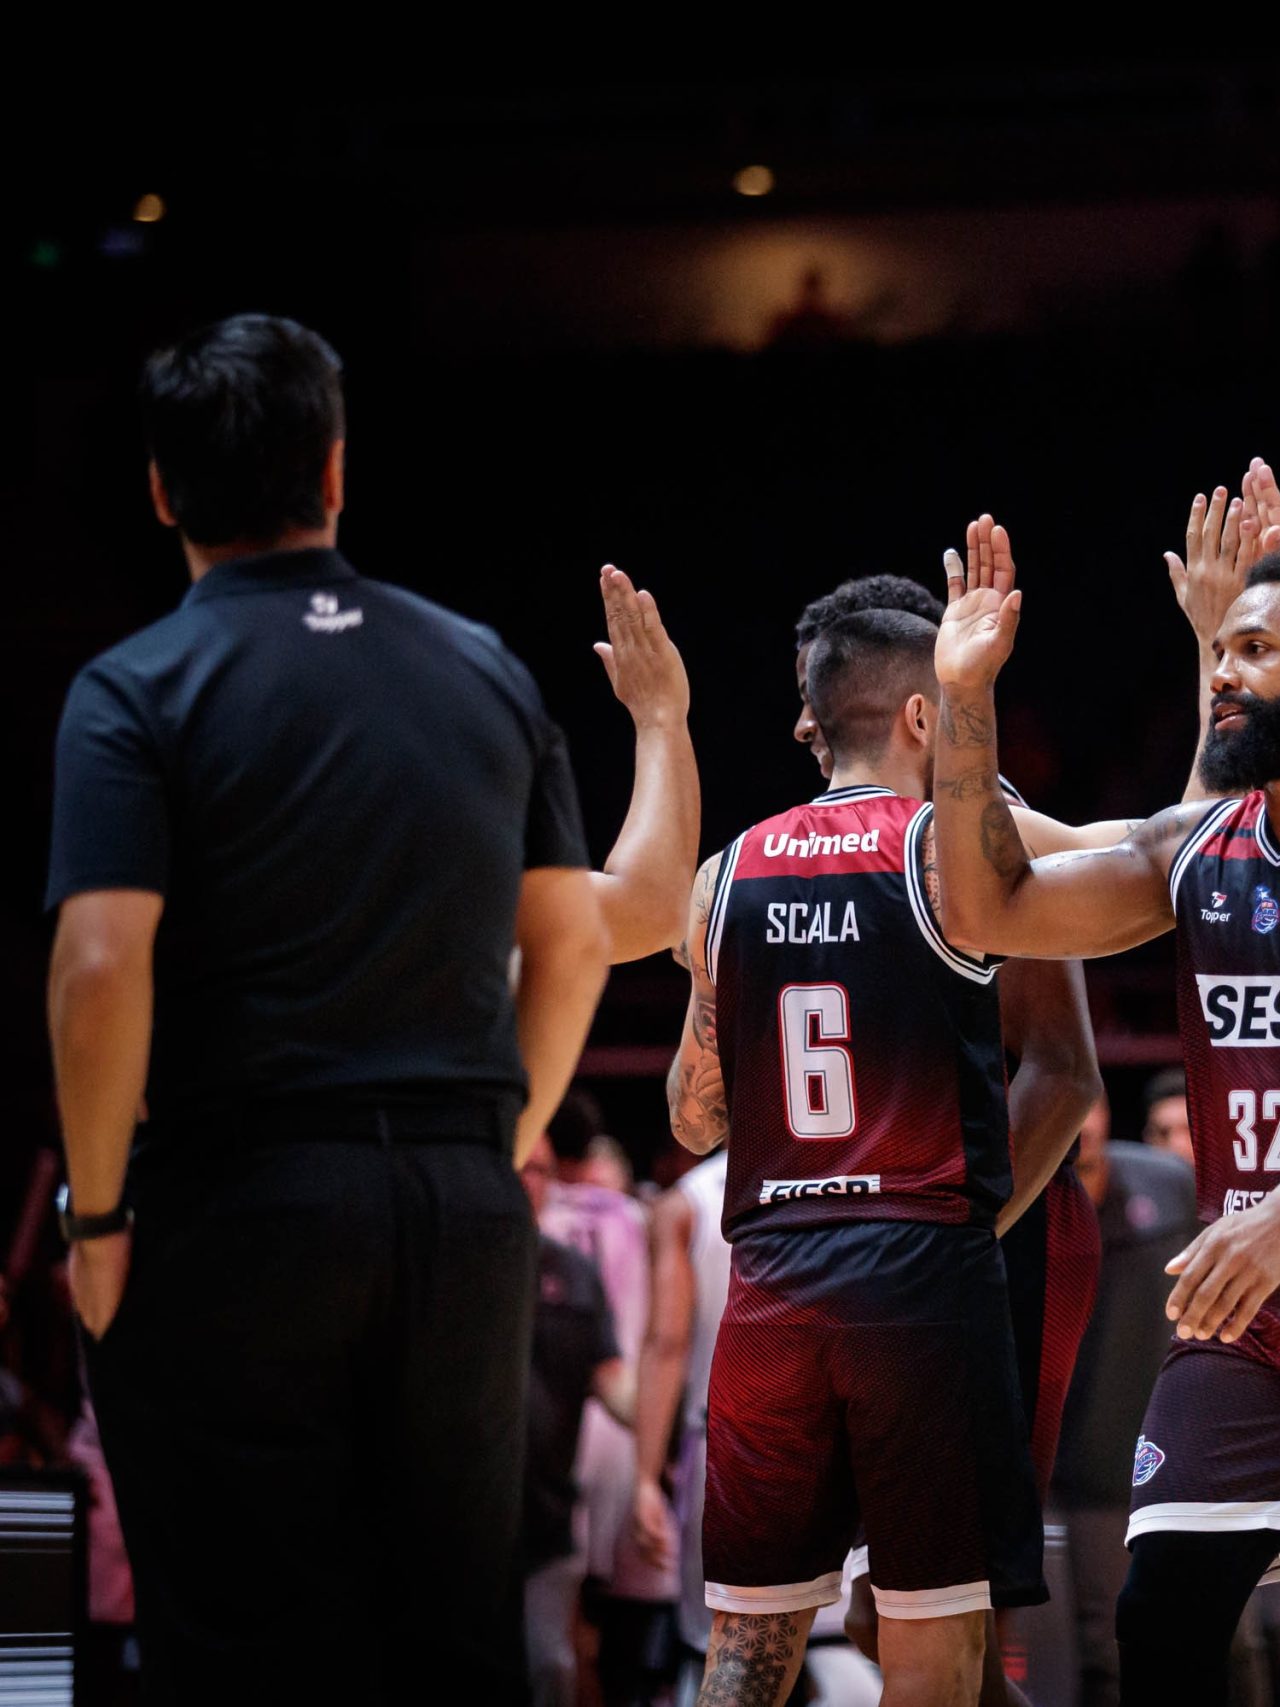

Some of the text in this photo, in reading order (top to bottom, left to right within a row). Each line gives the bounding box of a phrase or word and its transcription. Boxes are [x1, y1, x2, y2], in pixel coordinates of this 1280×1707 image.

[763, 828, 881, 858] Unimed
[766, 901, 861, 944] SCALA
[777, 981, 860, 1141] 6
